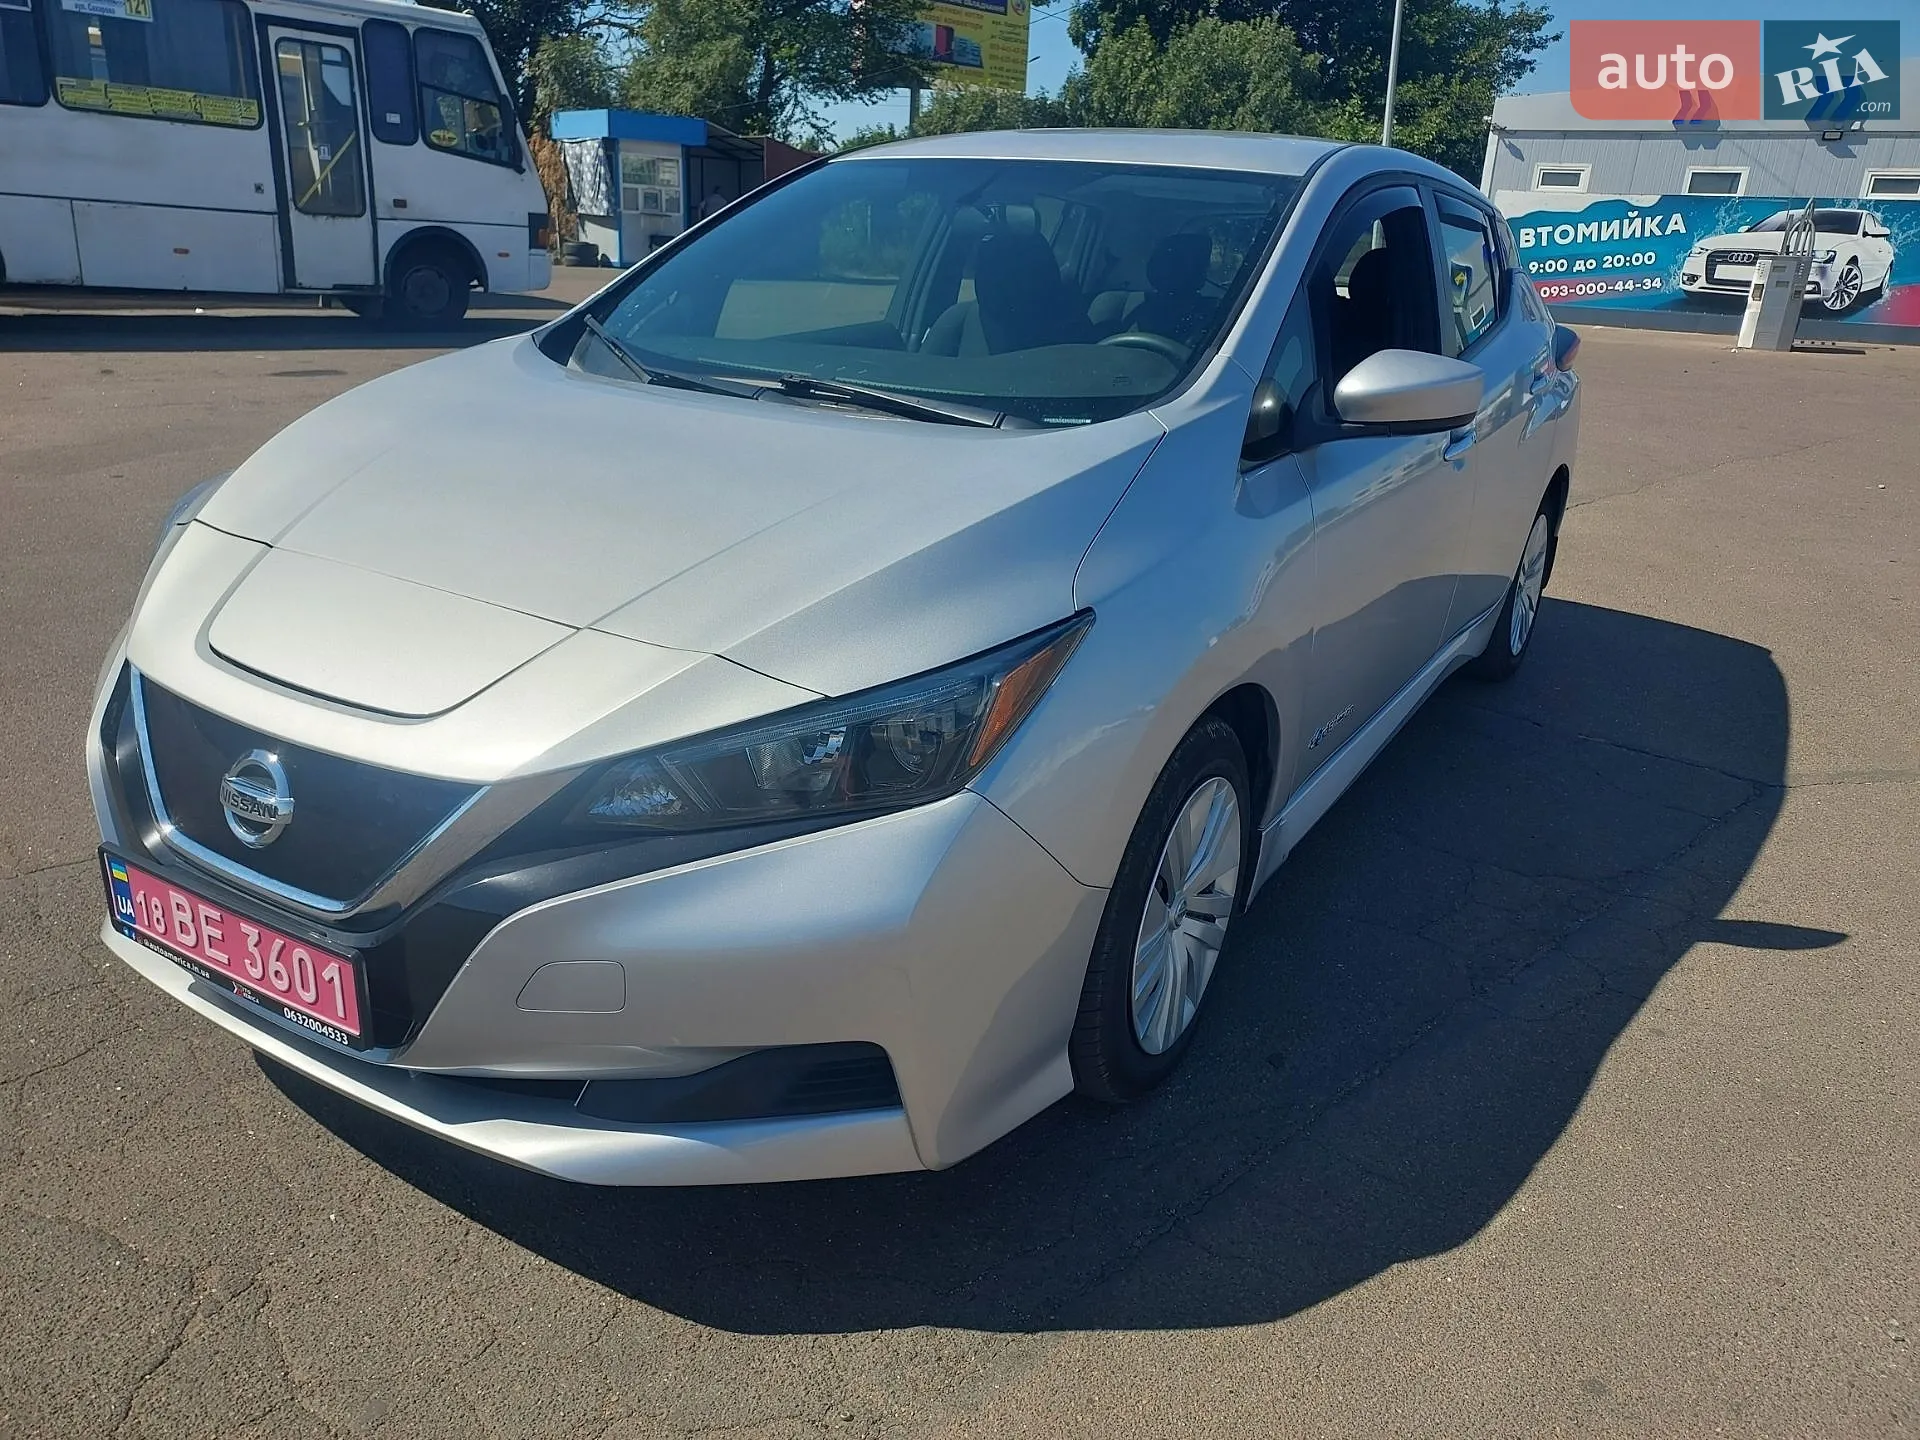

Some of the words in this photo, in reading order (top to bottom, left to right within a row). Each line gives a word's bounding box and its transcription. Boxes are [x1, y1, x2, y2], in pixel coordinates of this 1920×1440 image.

[1519, 210, 1687, 249] ВТОМИЙКА
[1528, 259, 1568, 274] 9:00
[1573, 258, 1597, 273] до
[1602, 251, 1656, 269] 20:00
[1540, 277, 1662, 298] 093-000-44-34
[221, 785, 279, 819] NISSAN
[117, 894, 135, 918] UA
[136, 890, 167, 935] 18
[168, 890, 230, 966] BE
[239, 922, 347, 1020] 3601
[283, 1006, 349, 1045] 0632004533
